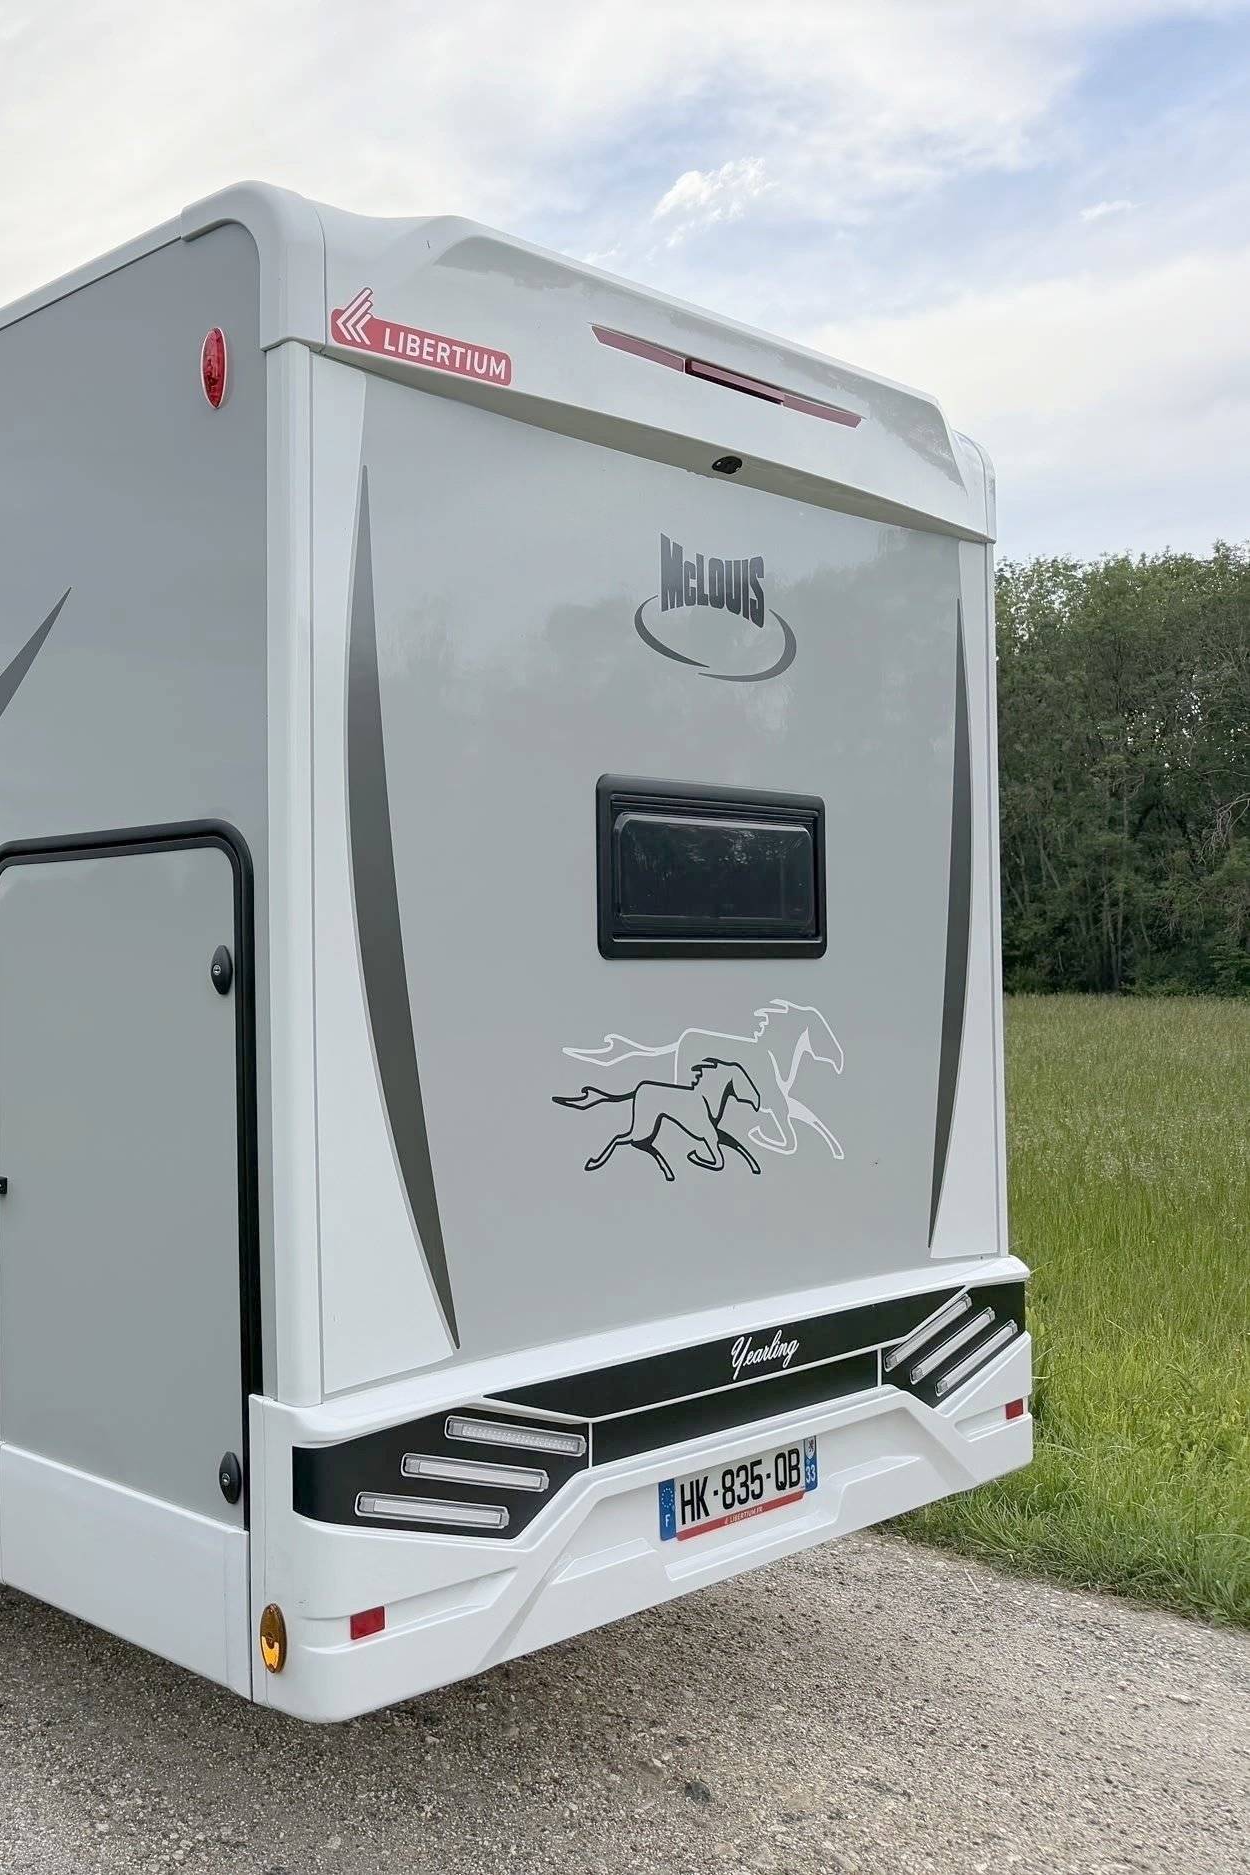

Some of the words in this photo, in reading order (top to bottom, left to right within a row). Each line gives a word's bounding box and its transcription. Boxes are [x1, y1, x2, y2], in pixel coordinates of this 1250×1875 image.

[383, 327, 506, 380] LIBERTIUM
[660, 532, 765, 629] McLOUIS
[731, 1329, 799, 1381] Yearling
[805, 1464, 817, 1484] 33
[664, 1514, 671, 1528] F
